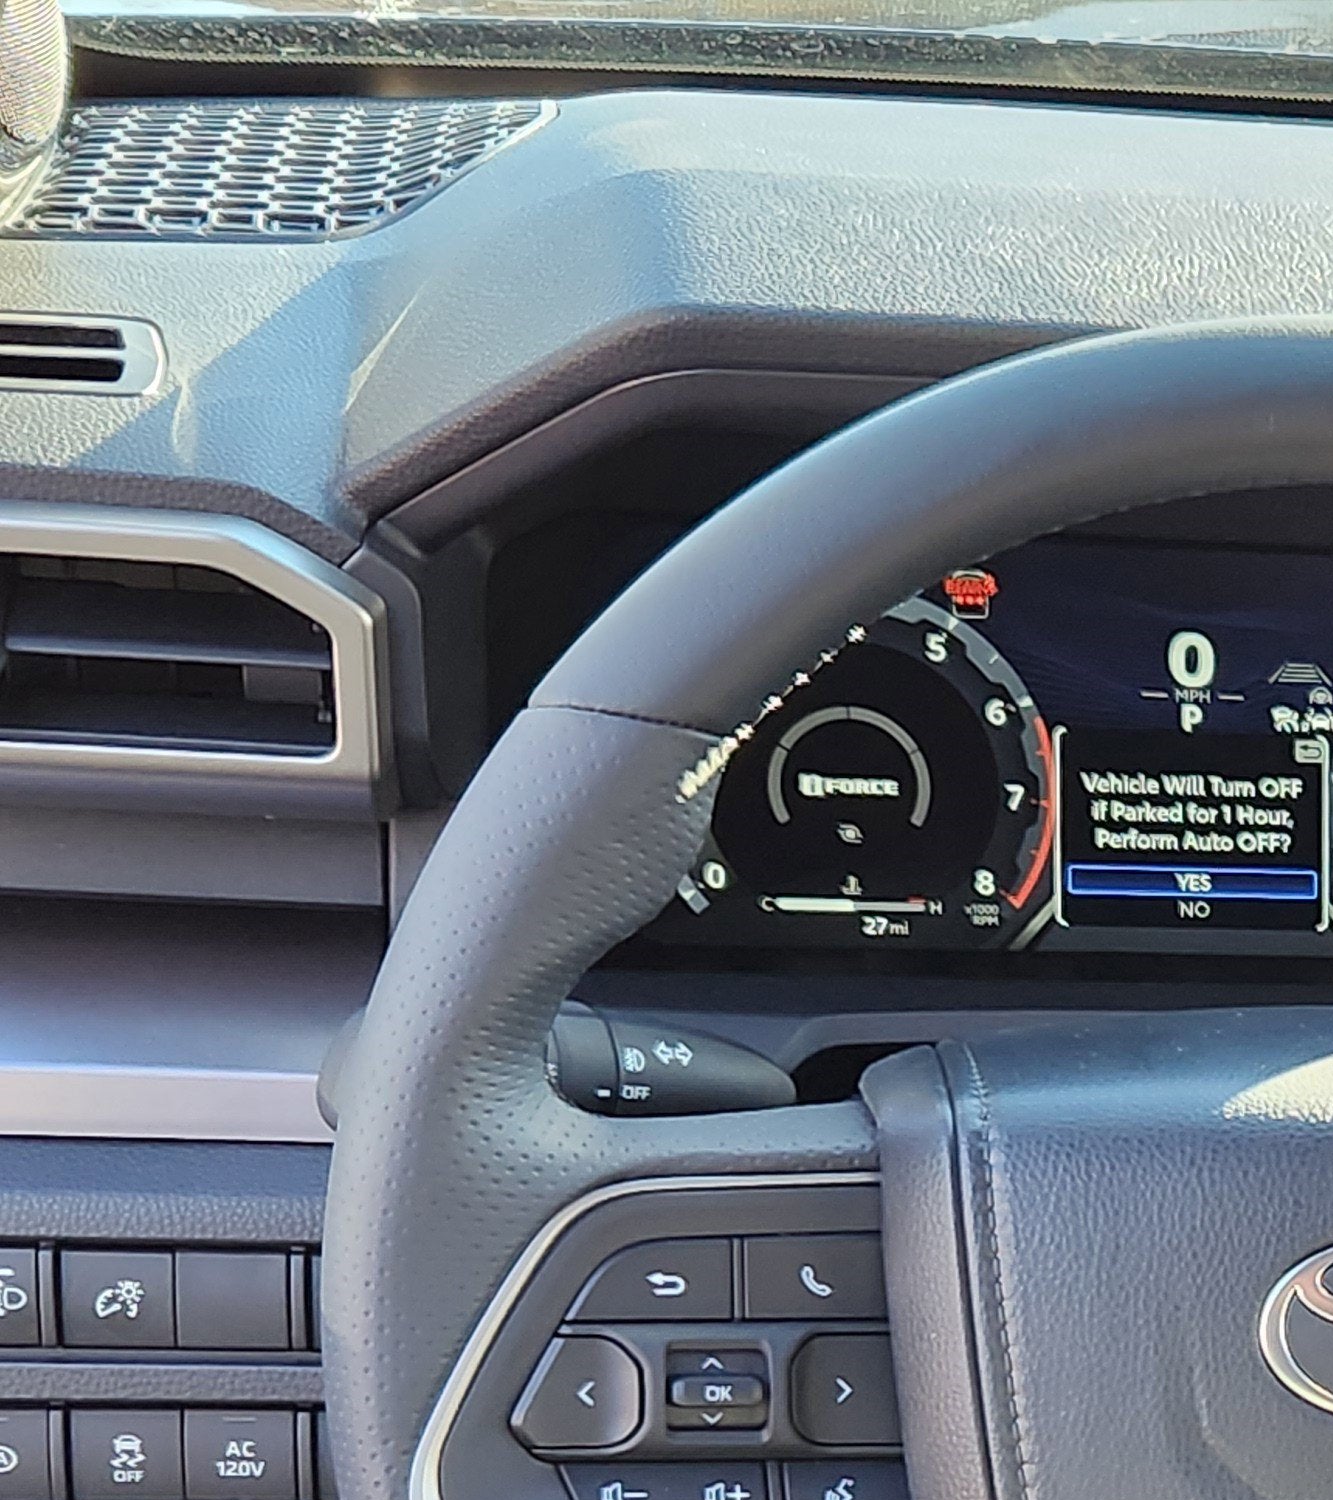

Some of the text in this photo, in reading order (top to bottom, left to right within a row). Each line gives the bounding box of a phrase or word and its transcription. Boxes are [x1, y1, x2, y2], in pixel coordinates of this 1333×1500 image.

[925, 632, 947, 662] 5
[1167, 631, 1215, 688] 0
[1175, 688, 1212, 704] MPH
[984, 700, 1008, 725] 6
[1181, 703, 1203, 733] P
[1080, 771, 1303, 799] Vehicle Will Turn OFF
[1004, 785, 1025, 811] 7
[1111, 800, 1184, 824] Parked
[1186, 802, 1218, 825] for
[1221, 804, 1231, 825] 1
[1235, 805, 1294, 829] Hour,
[1094, 827, 1292, 853] Perform Auto OFF?
[702, 861, 727, 890] 0
[974, 869, 997, 897] 8
[1175, 872, 1212, 893] YES
[928, 902, 943, 915] H
[1177, 901, 1210, 919] NO
[862, 917, 910, 936] 27 mi
[621, 1084, 651, 1100] OFF
[705, 1385, 733, 1402] OK
[225, 1441, 256, 1458] AC
[114, 1470, 145, 1483] OFF
[216, 1461, 265, 1478] 120V
